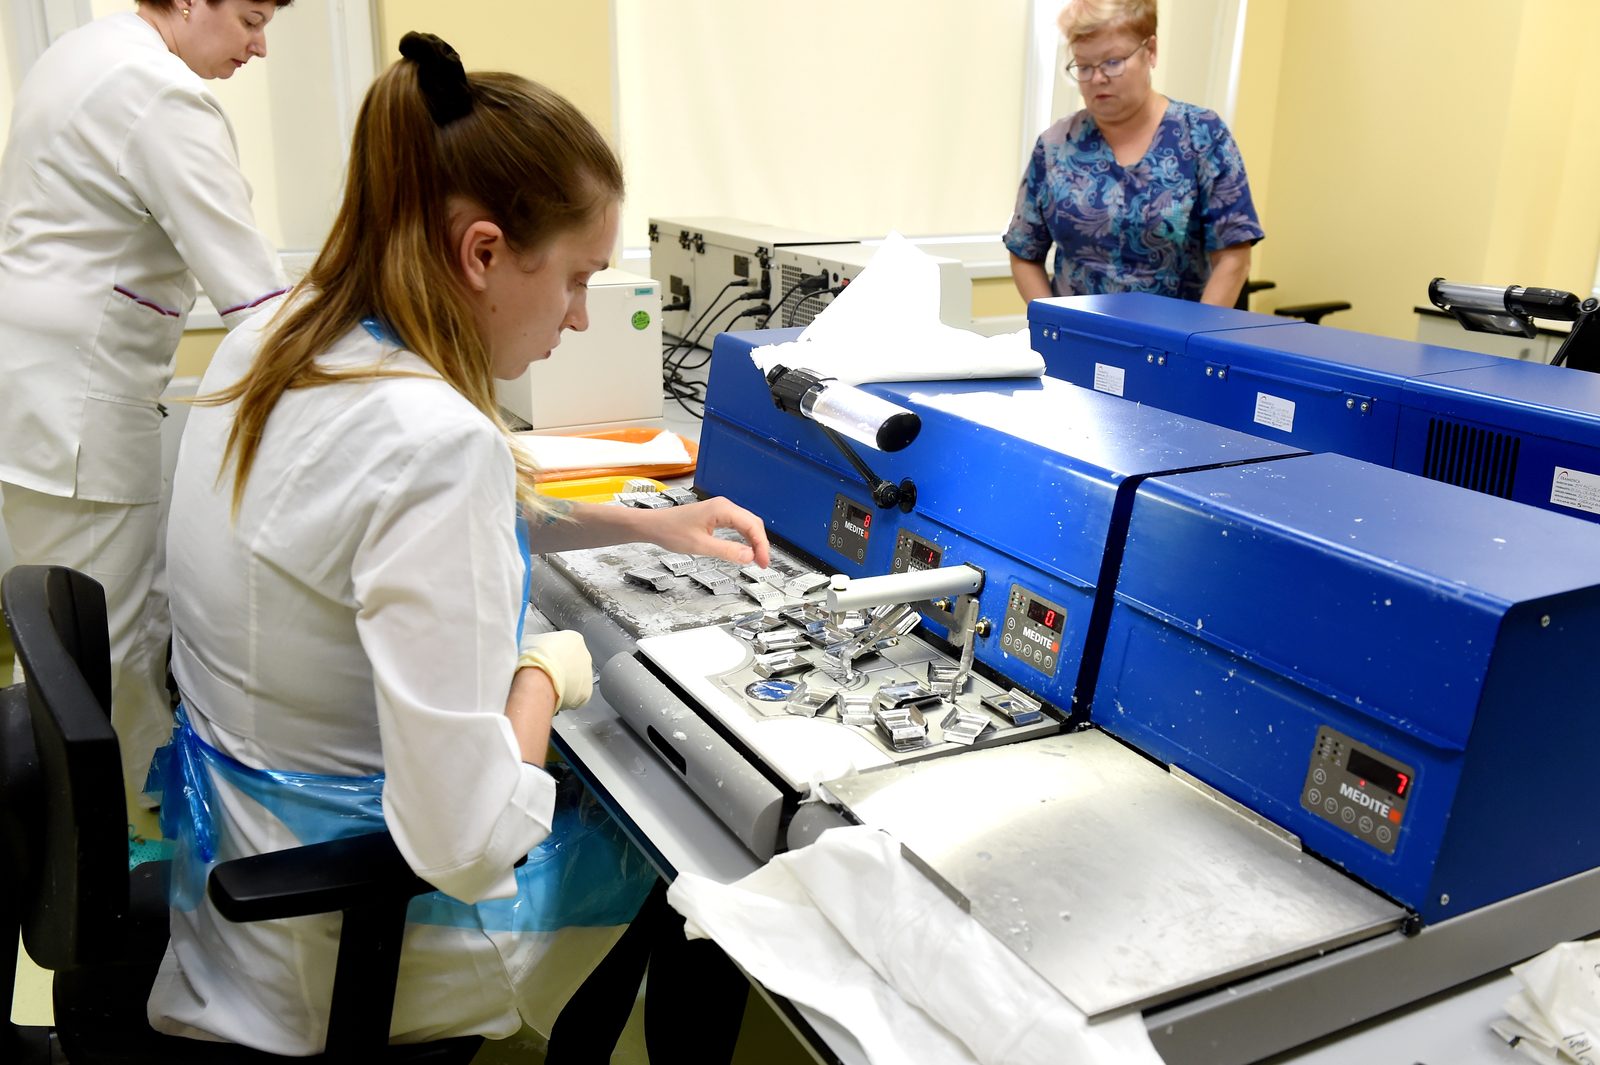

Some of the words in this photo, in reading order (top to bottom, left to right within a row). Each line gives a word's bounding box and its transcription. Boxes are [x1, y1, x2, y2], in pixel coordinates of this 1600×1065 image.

[844, 520, 865, 537] MEDITE
[864, 514, 871, 528] 8
[1022, 626, 1053, 650] MEDITE
[1397, 772, 1409, 794] 7
[1340, 782, 1390, 818] MEDITE
